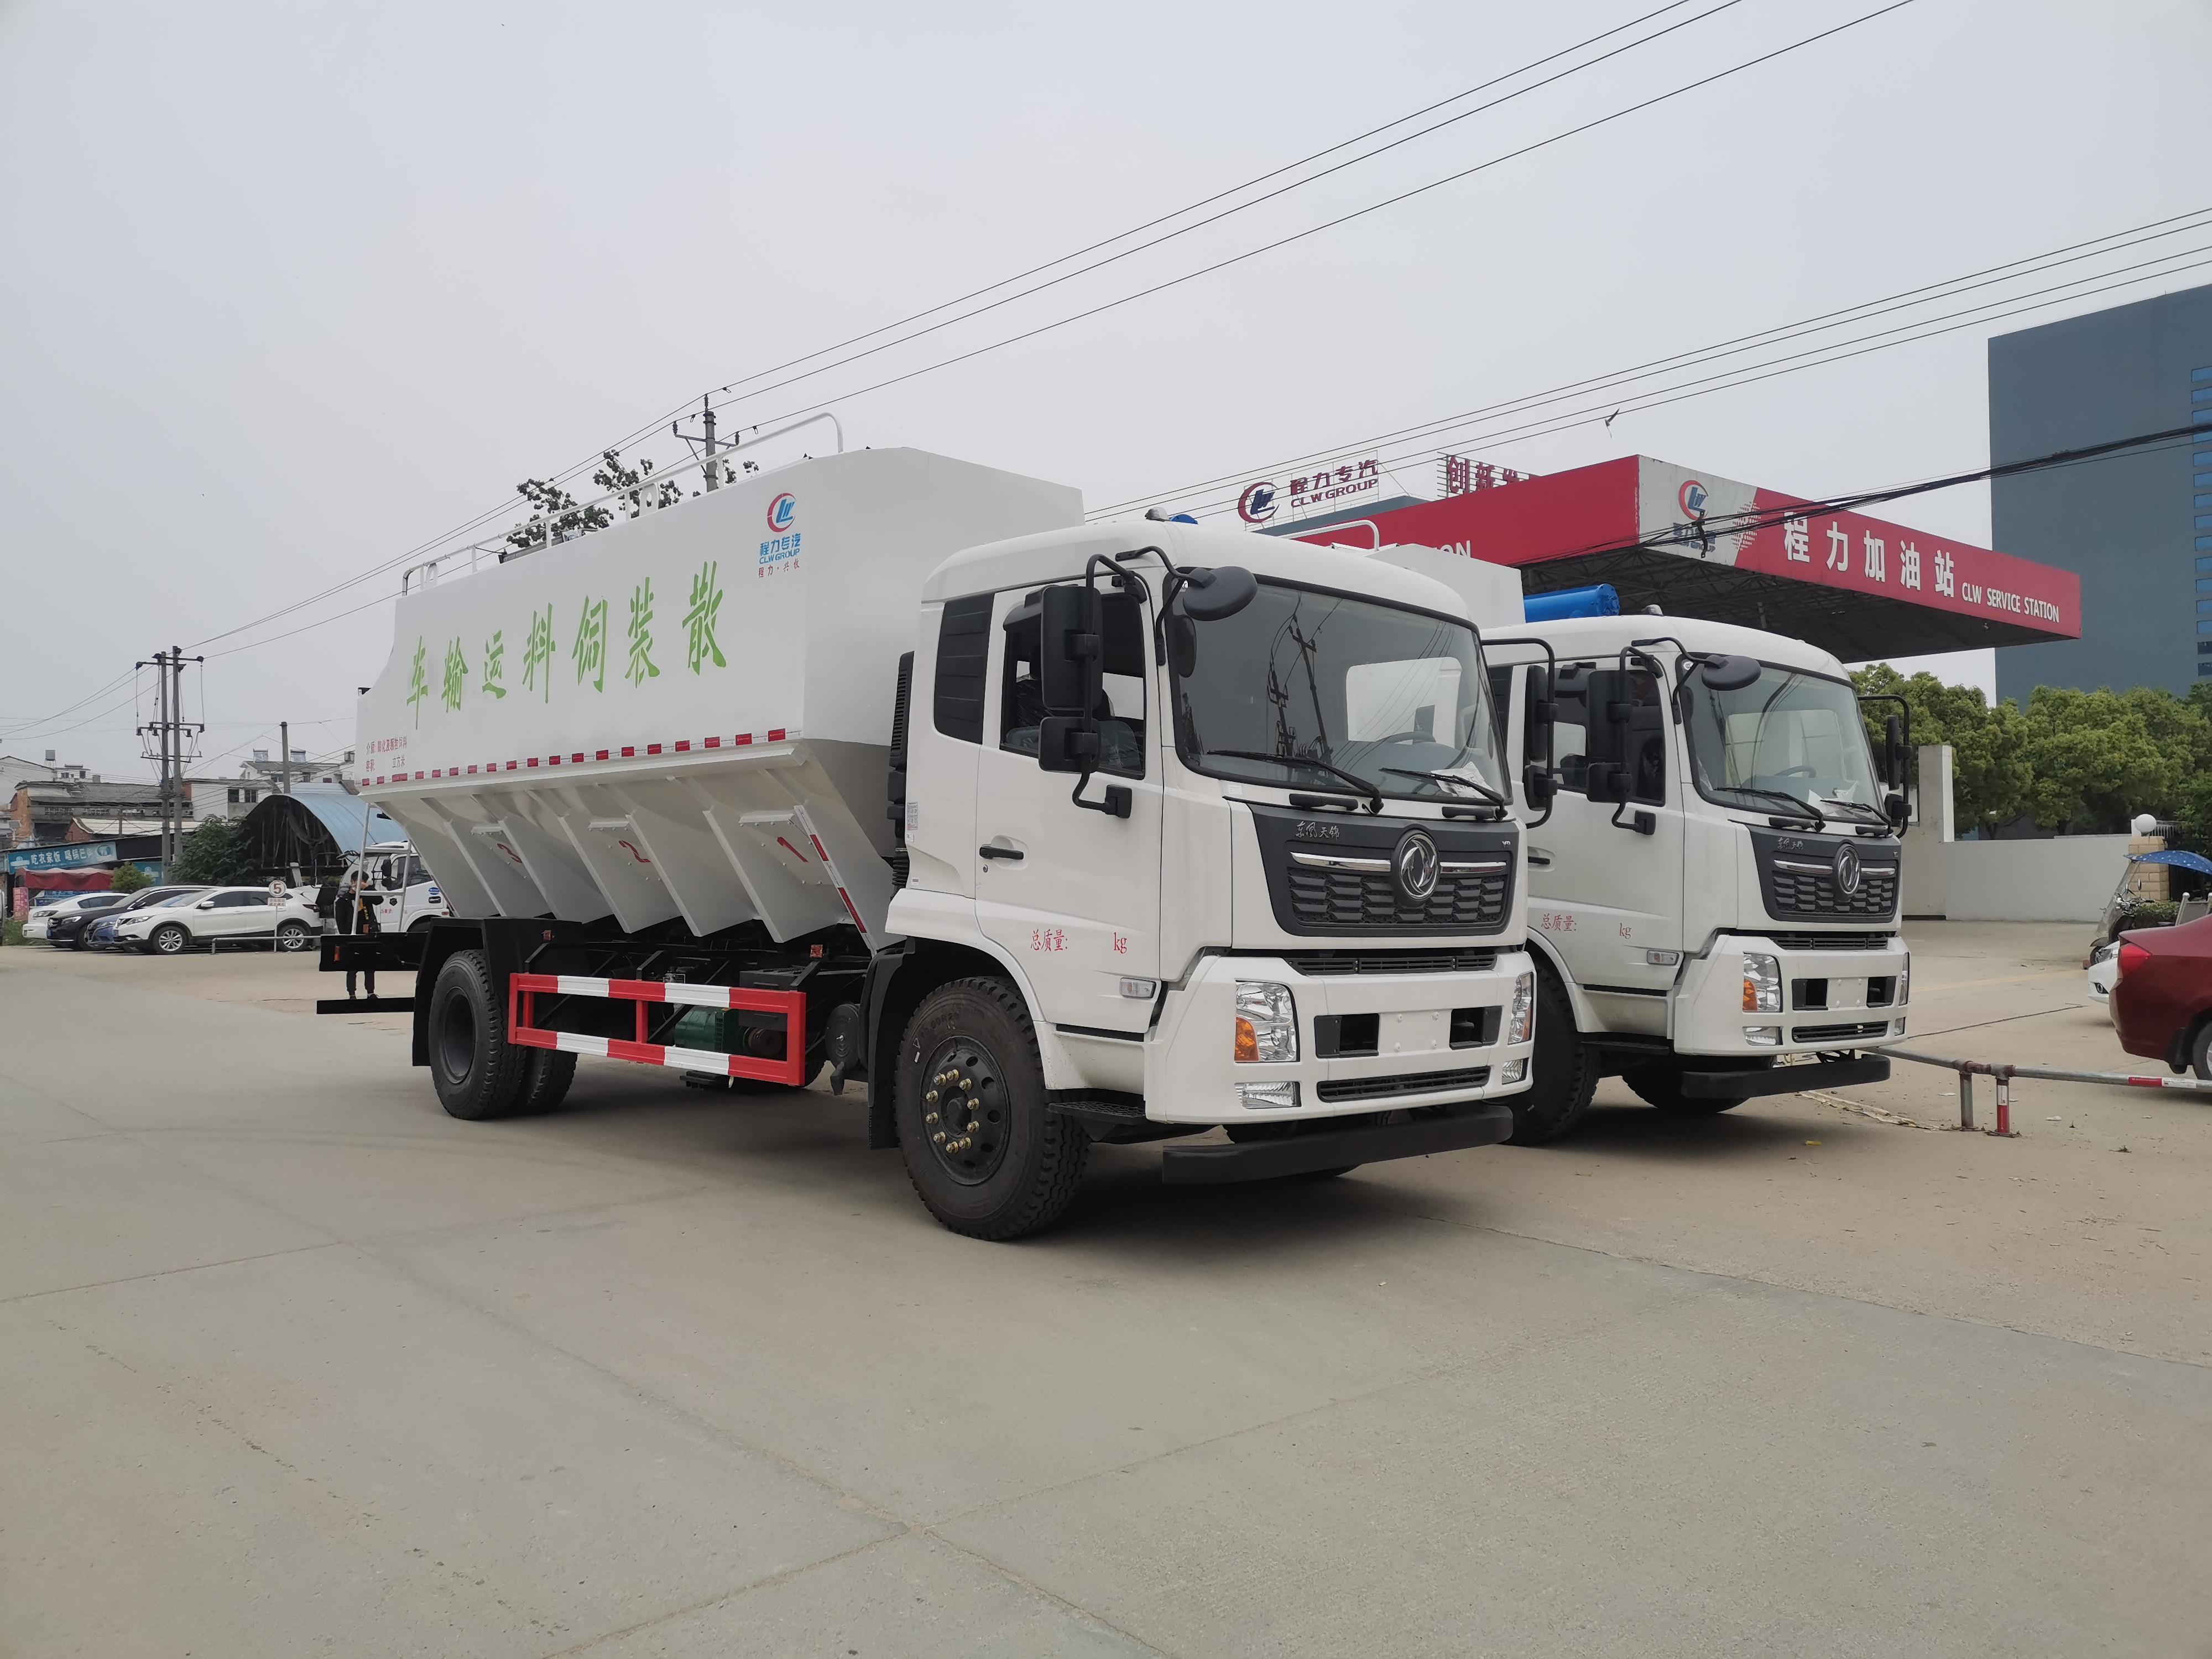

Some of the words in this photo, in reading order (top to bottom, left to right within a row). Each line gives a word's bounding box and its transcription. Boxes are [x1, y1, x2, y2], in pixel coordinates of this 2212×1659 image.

[1326, 478, 1378, 499] GROUP
[1783, 511, 1955, 598] 程力加油站
[1962, 582, 1981, 604] CLW
[1987, 588, 2021, 613] SERVICE
[2024, 597, 2059, 623] STATION
[274, 883, 282, 894] 5
[1619, 922, 1631, 939] kg
[1113, 931, 1127, 954] kg
